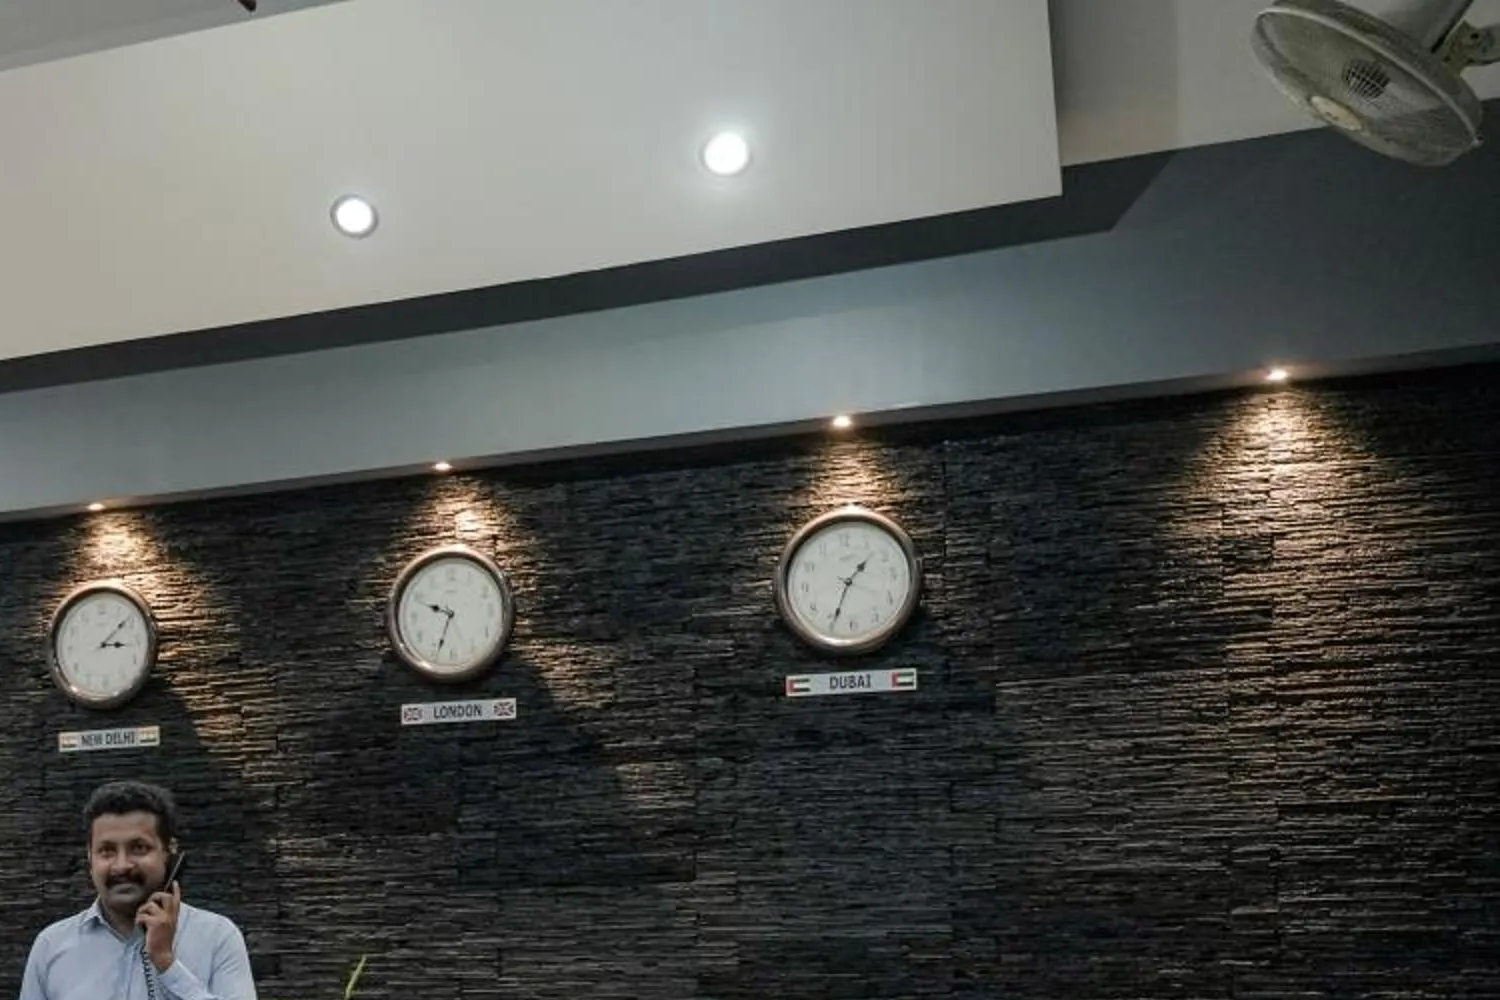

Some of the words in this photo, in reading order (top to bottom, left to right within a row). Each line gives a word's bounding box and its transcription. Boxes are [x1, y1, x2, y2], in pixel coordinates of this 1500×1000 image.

[829, 675, 872, 690] DUBAI
[433, 704, 483, 719] LONDON
[81, 734, 103, 745] NEW
[106, 731, 136, 744] DELHI
